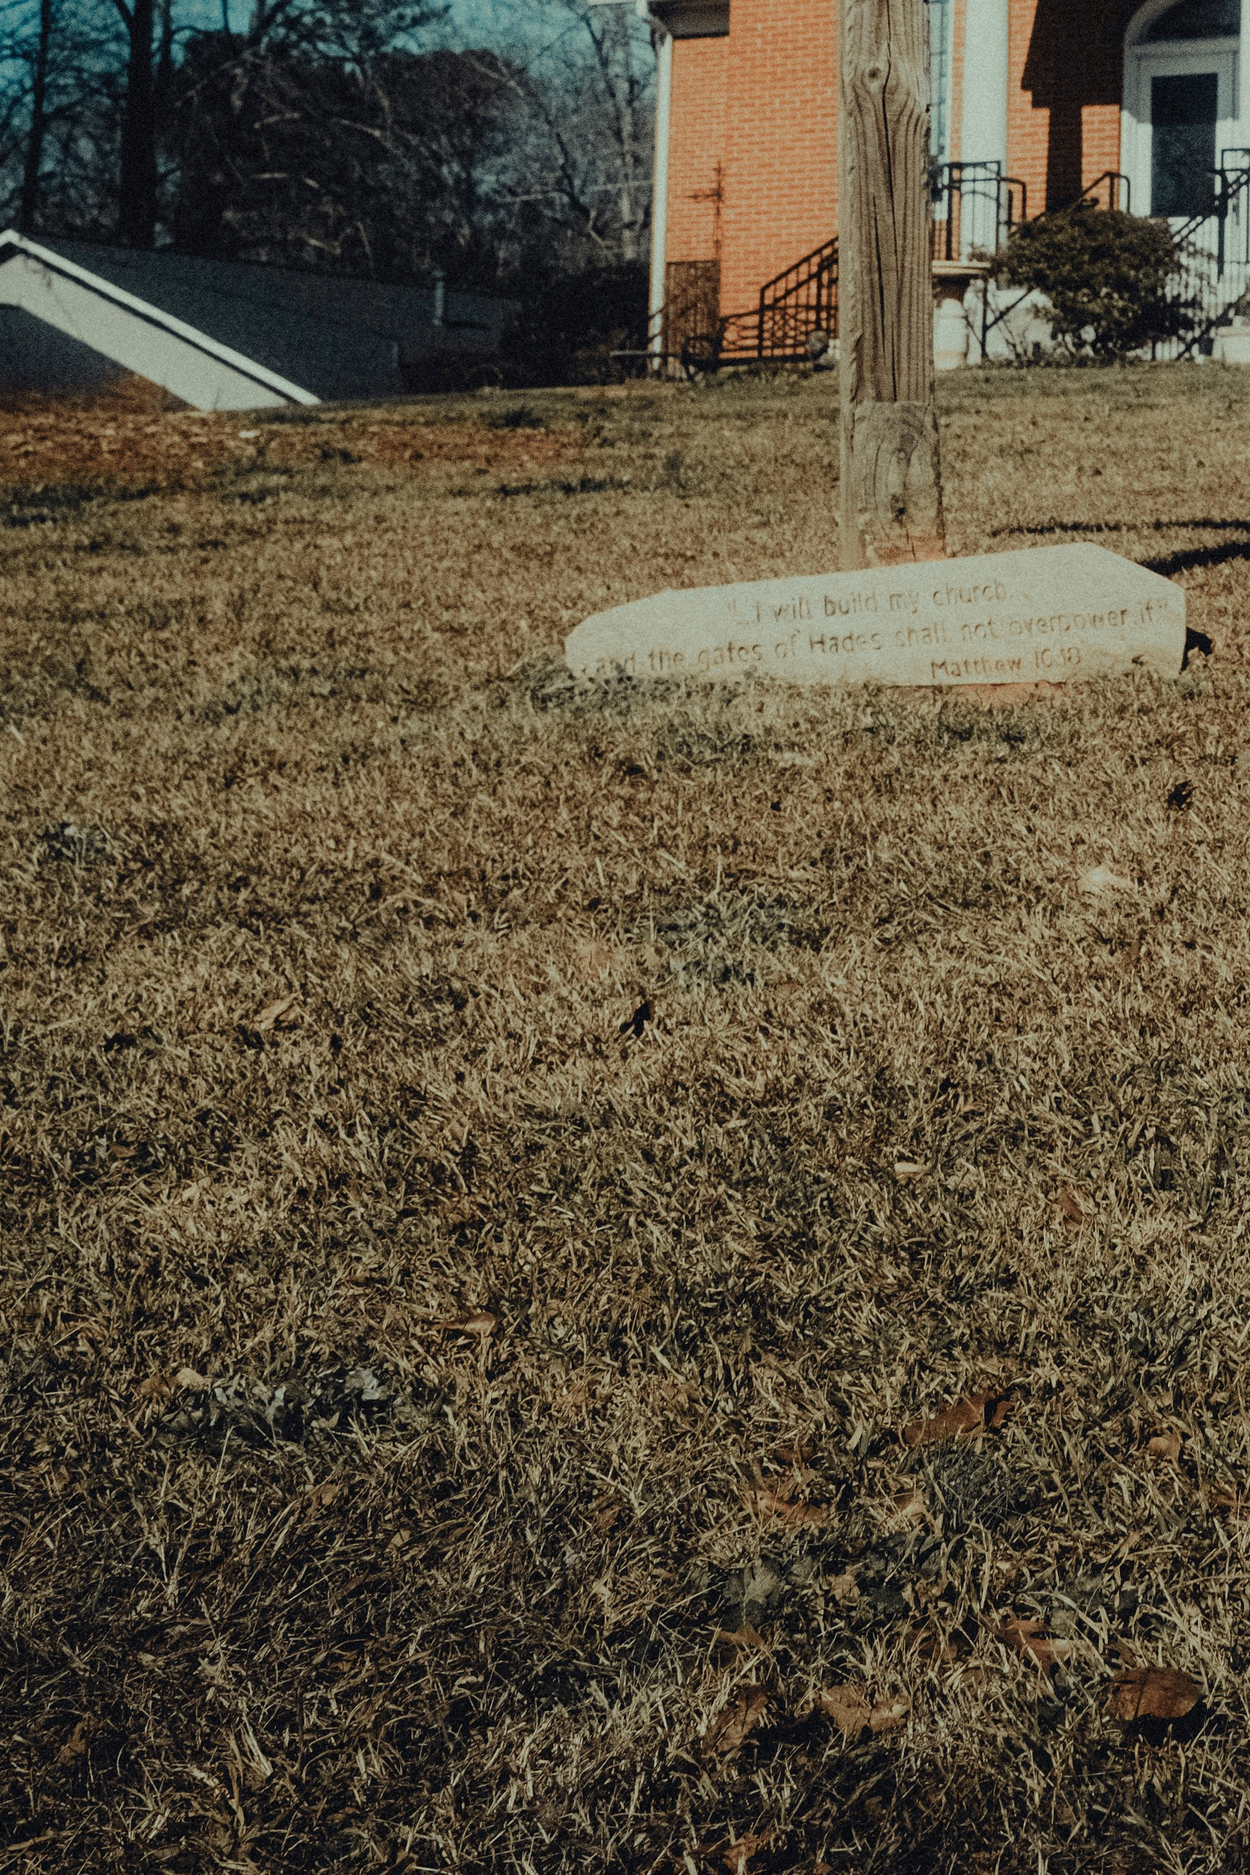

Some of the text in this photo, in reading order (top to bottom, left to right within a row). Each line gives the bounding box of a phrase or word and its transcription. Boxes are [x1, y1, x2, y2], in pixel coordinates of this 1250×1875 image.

[769, 595, 814, 623] will
[823, 591, 880, 618] build
[889, 589, 919, 614] my
[648, 645, 686, 671] the
[698, 641, 764, 674] gates
[775, 627, 800, 659] of
[808, 629, 882, 655] Hades
[894, 620, 948, 650] shall
[961, 617, 1000, 642] not
[1008, 608, 1128, 639] overpower
[931, 655, 1022, 678] Matthew
